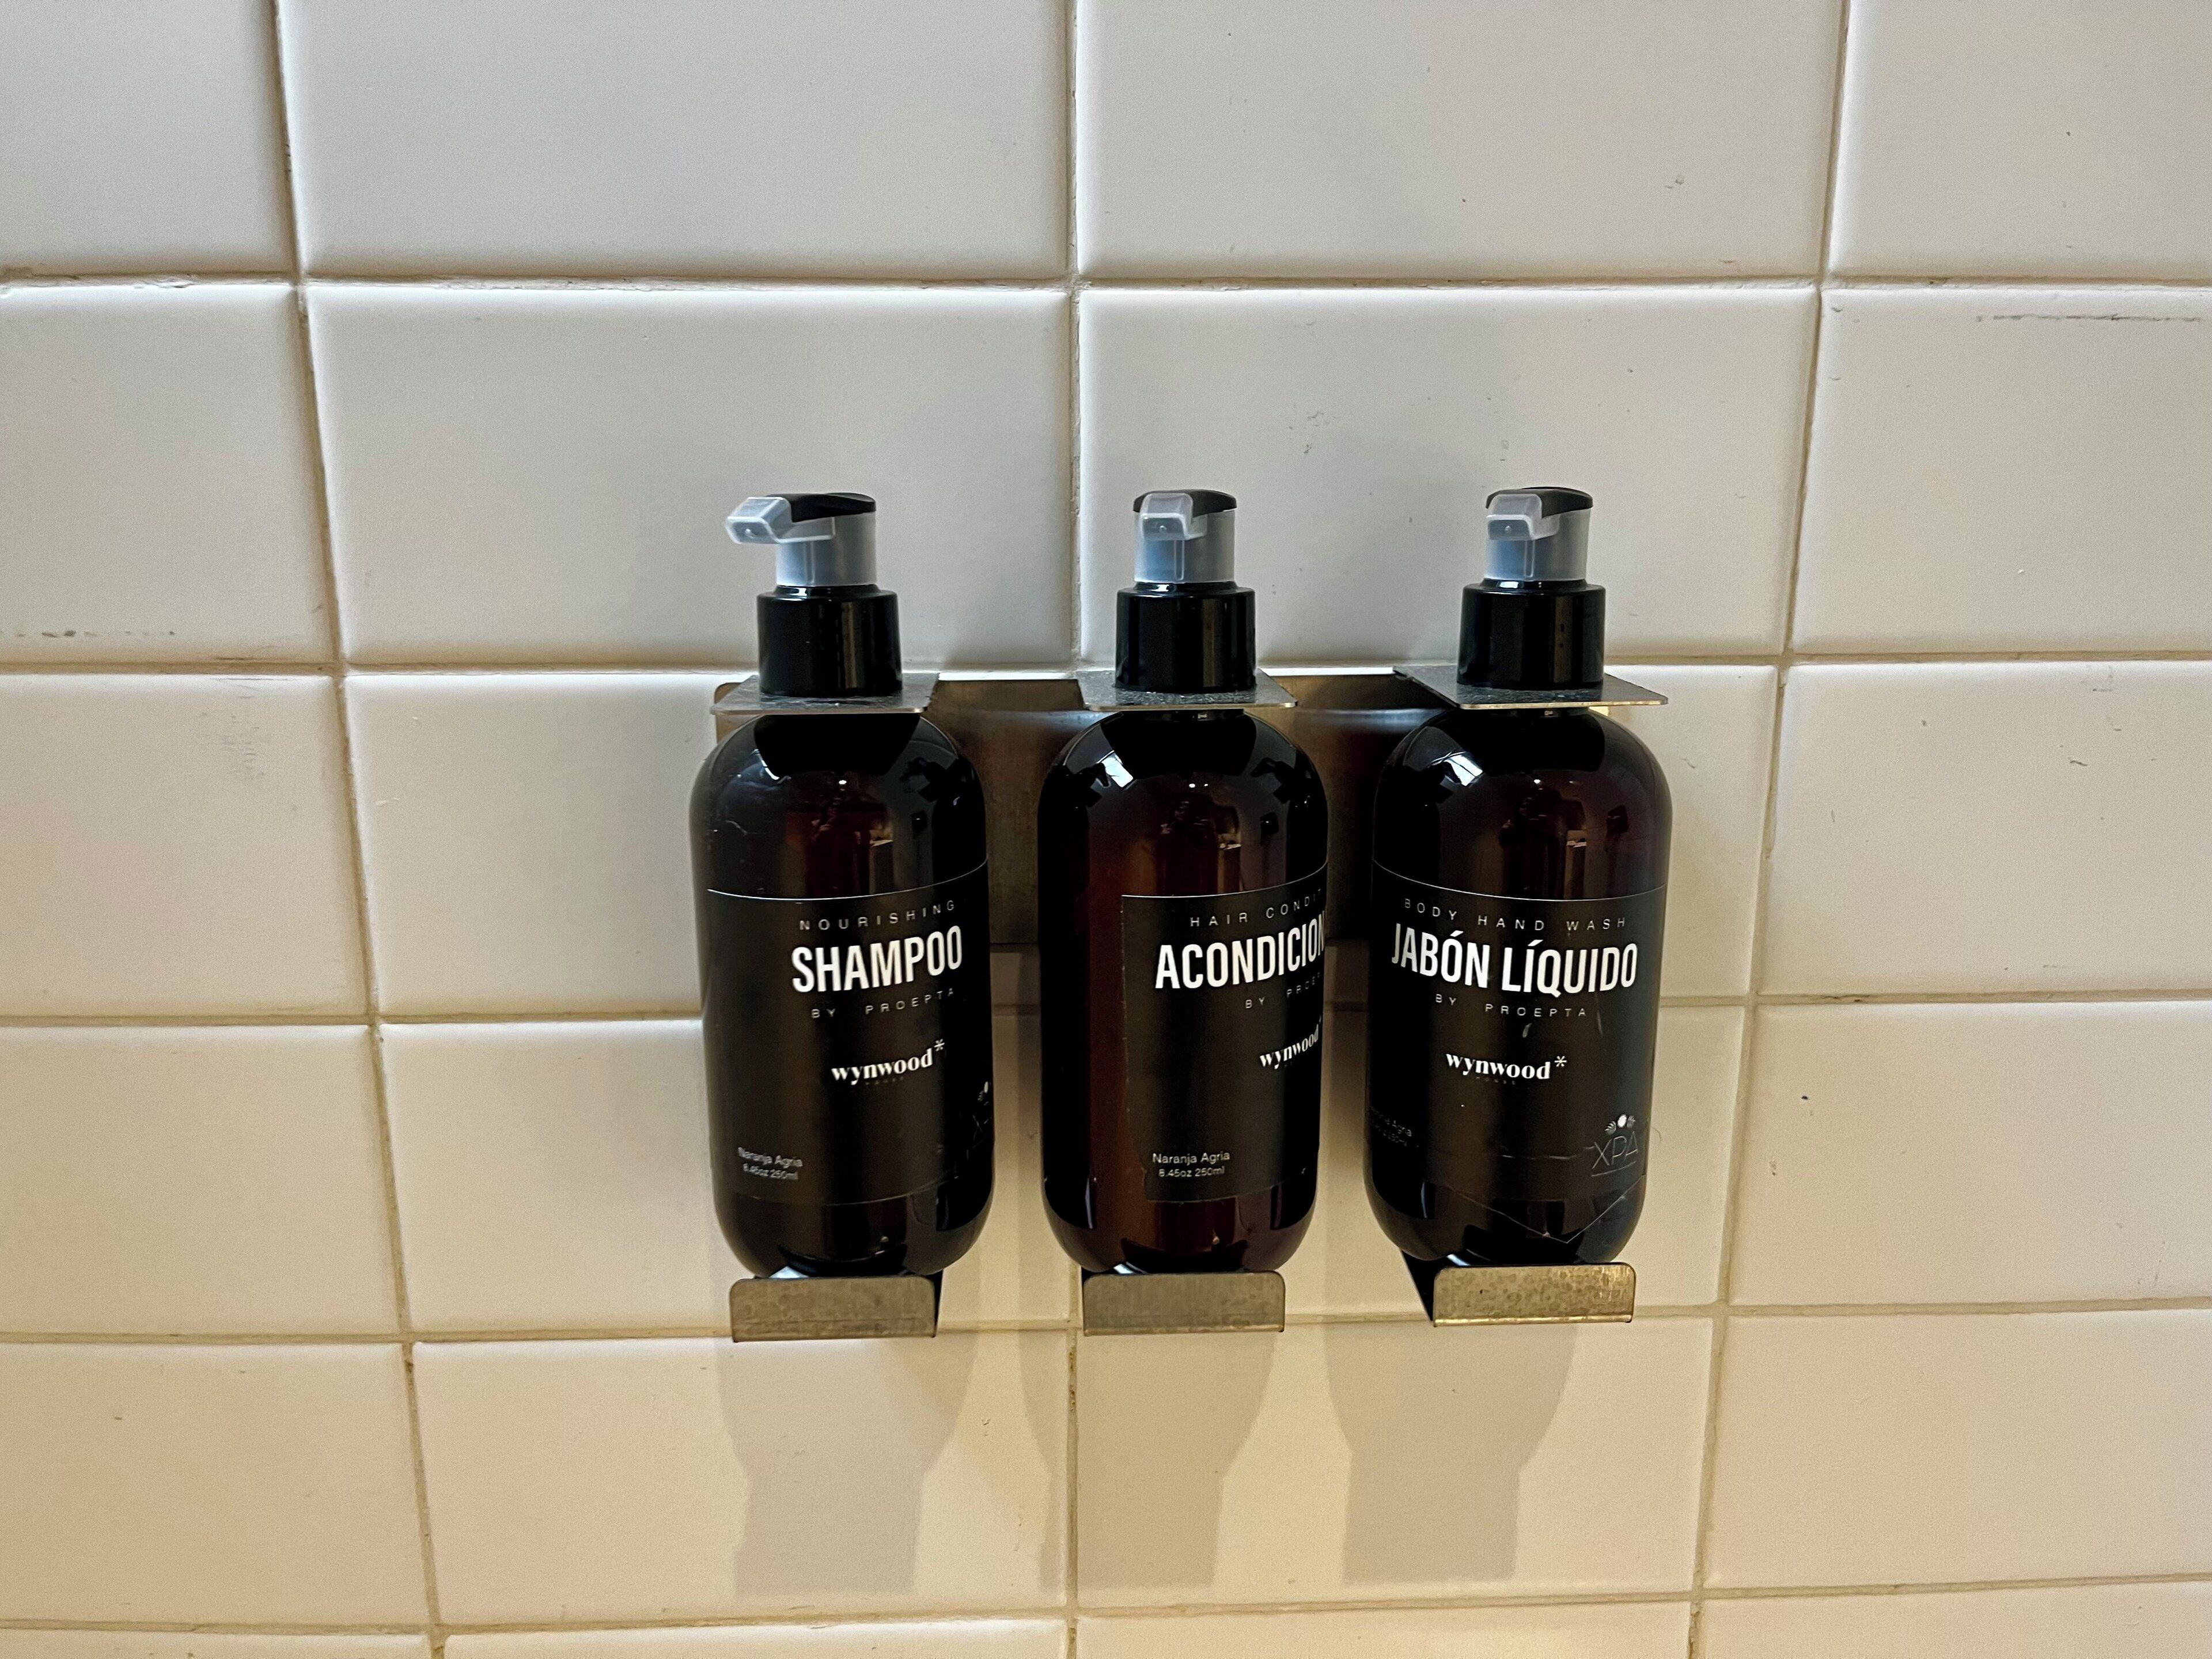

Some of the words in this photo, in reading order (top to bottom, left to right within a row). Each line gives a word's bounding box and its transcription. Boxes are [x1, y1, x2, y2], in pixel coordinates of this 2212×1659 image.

[800, 900, 955, 930] NOURISHING
[1190, 912, 1248, 927] HAIR
[1404, 898, 1457, 921] BODY
[1478, 915, 1545, 931] HAND
[1566, 917, 1626, 931] WASH
[791, 925, 963, 993] SHAMPOO
[1391, 923, 1491, 988] JABÓN
[1501, 939, 1638, 998] LÍQUIDO
[811, 1008, 836, 1019] BY
[865, 987, 955, 1015] PROEPTA
[1245, 997, 1265, 1009] BY
[1435, 994, 1457, 1006] BY
[1485, 1003, 1586, 1017] PROEPTA
[831, 1048, 933, 1085] wynwood
[1445, 1053, 1551, 1080] wynwood
[1153, 1153, 1197, 1166] Naranja
[1200, 1152, 1230, 1164] Agria
[1195, 1165, 1225, 1177] 250ml
